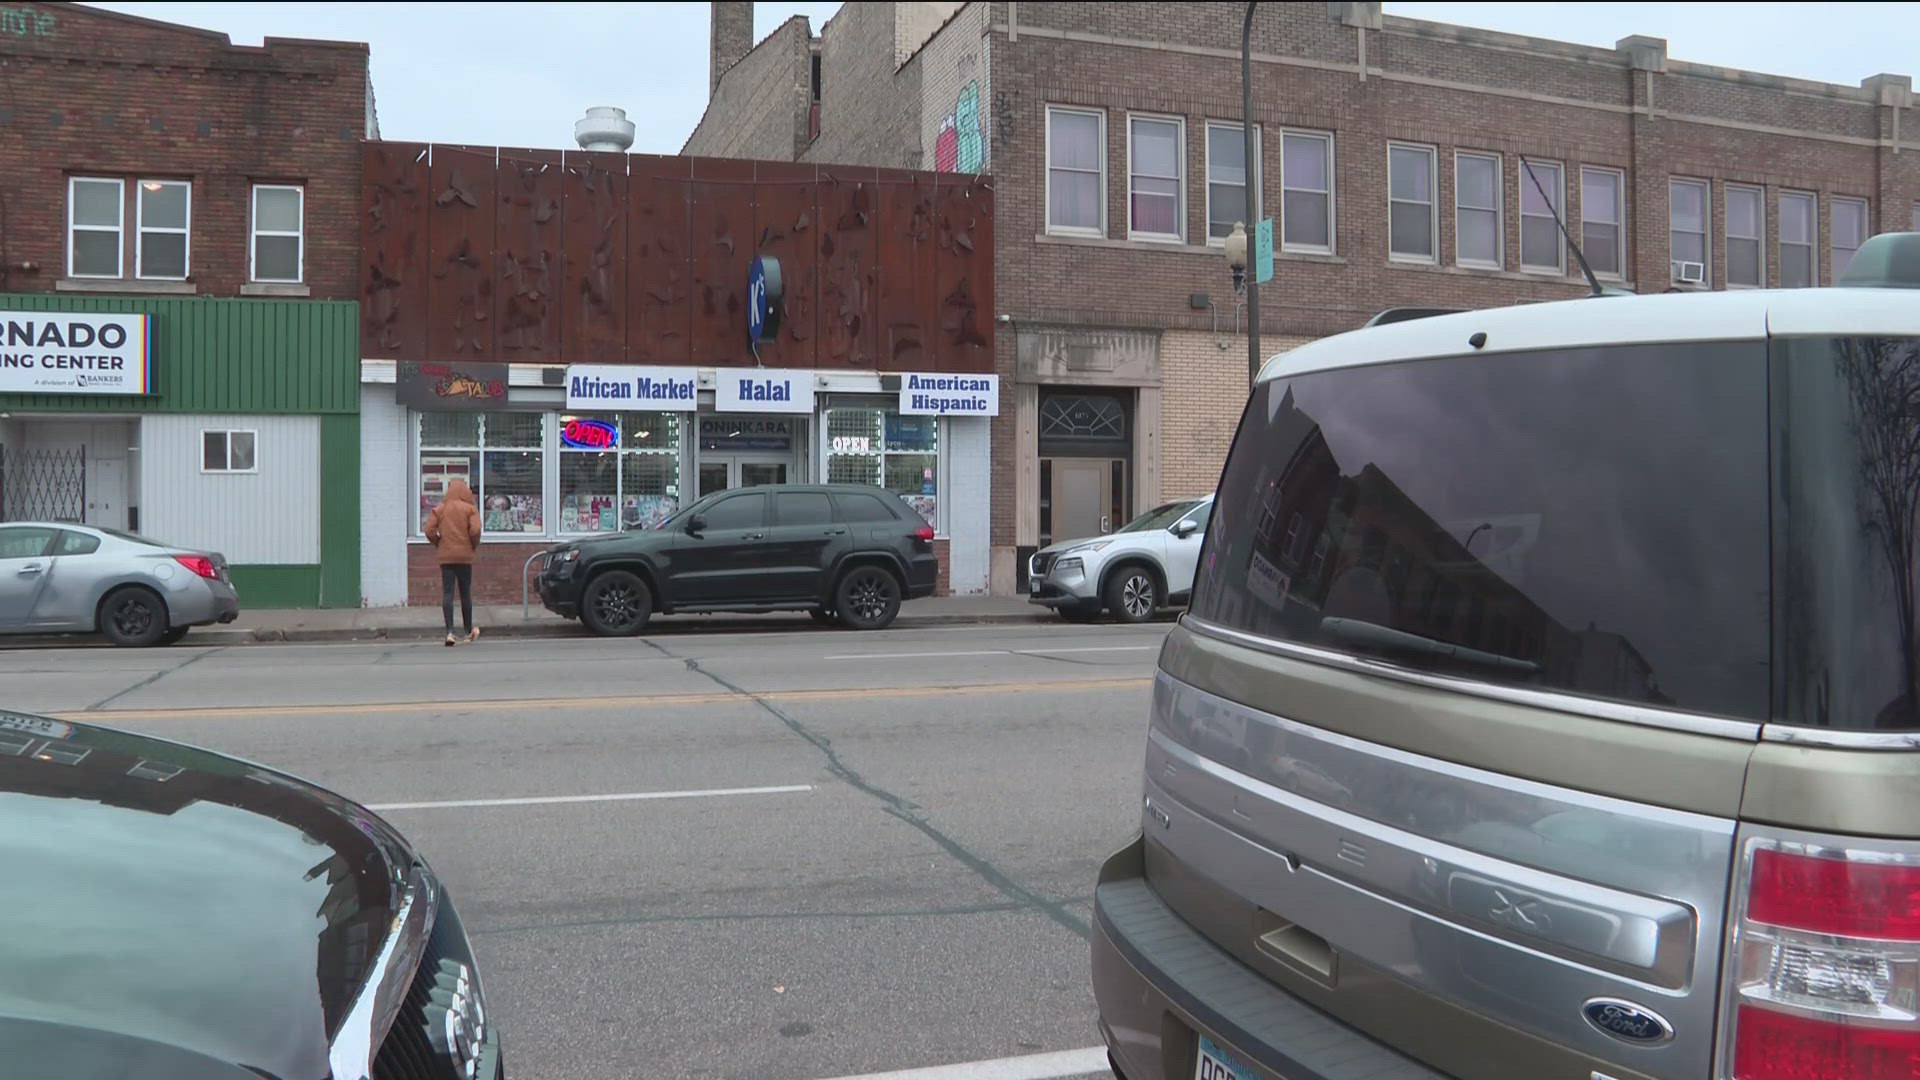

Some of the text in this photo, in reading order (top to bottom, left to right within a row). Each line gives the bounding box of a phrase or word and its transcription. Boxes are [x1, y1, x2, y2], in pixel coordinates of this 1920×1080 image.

[750, 273, 765, 327] K's
[0, 321, 126, 349] NADO
[41, 355, 123, 370] CENTER
[87, 375, 123, 383] BANKERS
[570, 376, 694, 400] African Market
[739, 379, 790, 401] Halal
[908, 375, 991, 391] American
[911, 395, 987, 413] Hispanic
[565, 421, 613, 449] OPEN
[832, 436, 870, 452] OPEN
[1599, 1004, 1650, 1037] Ford
